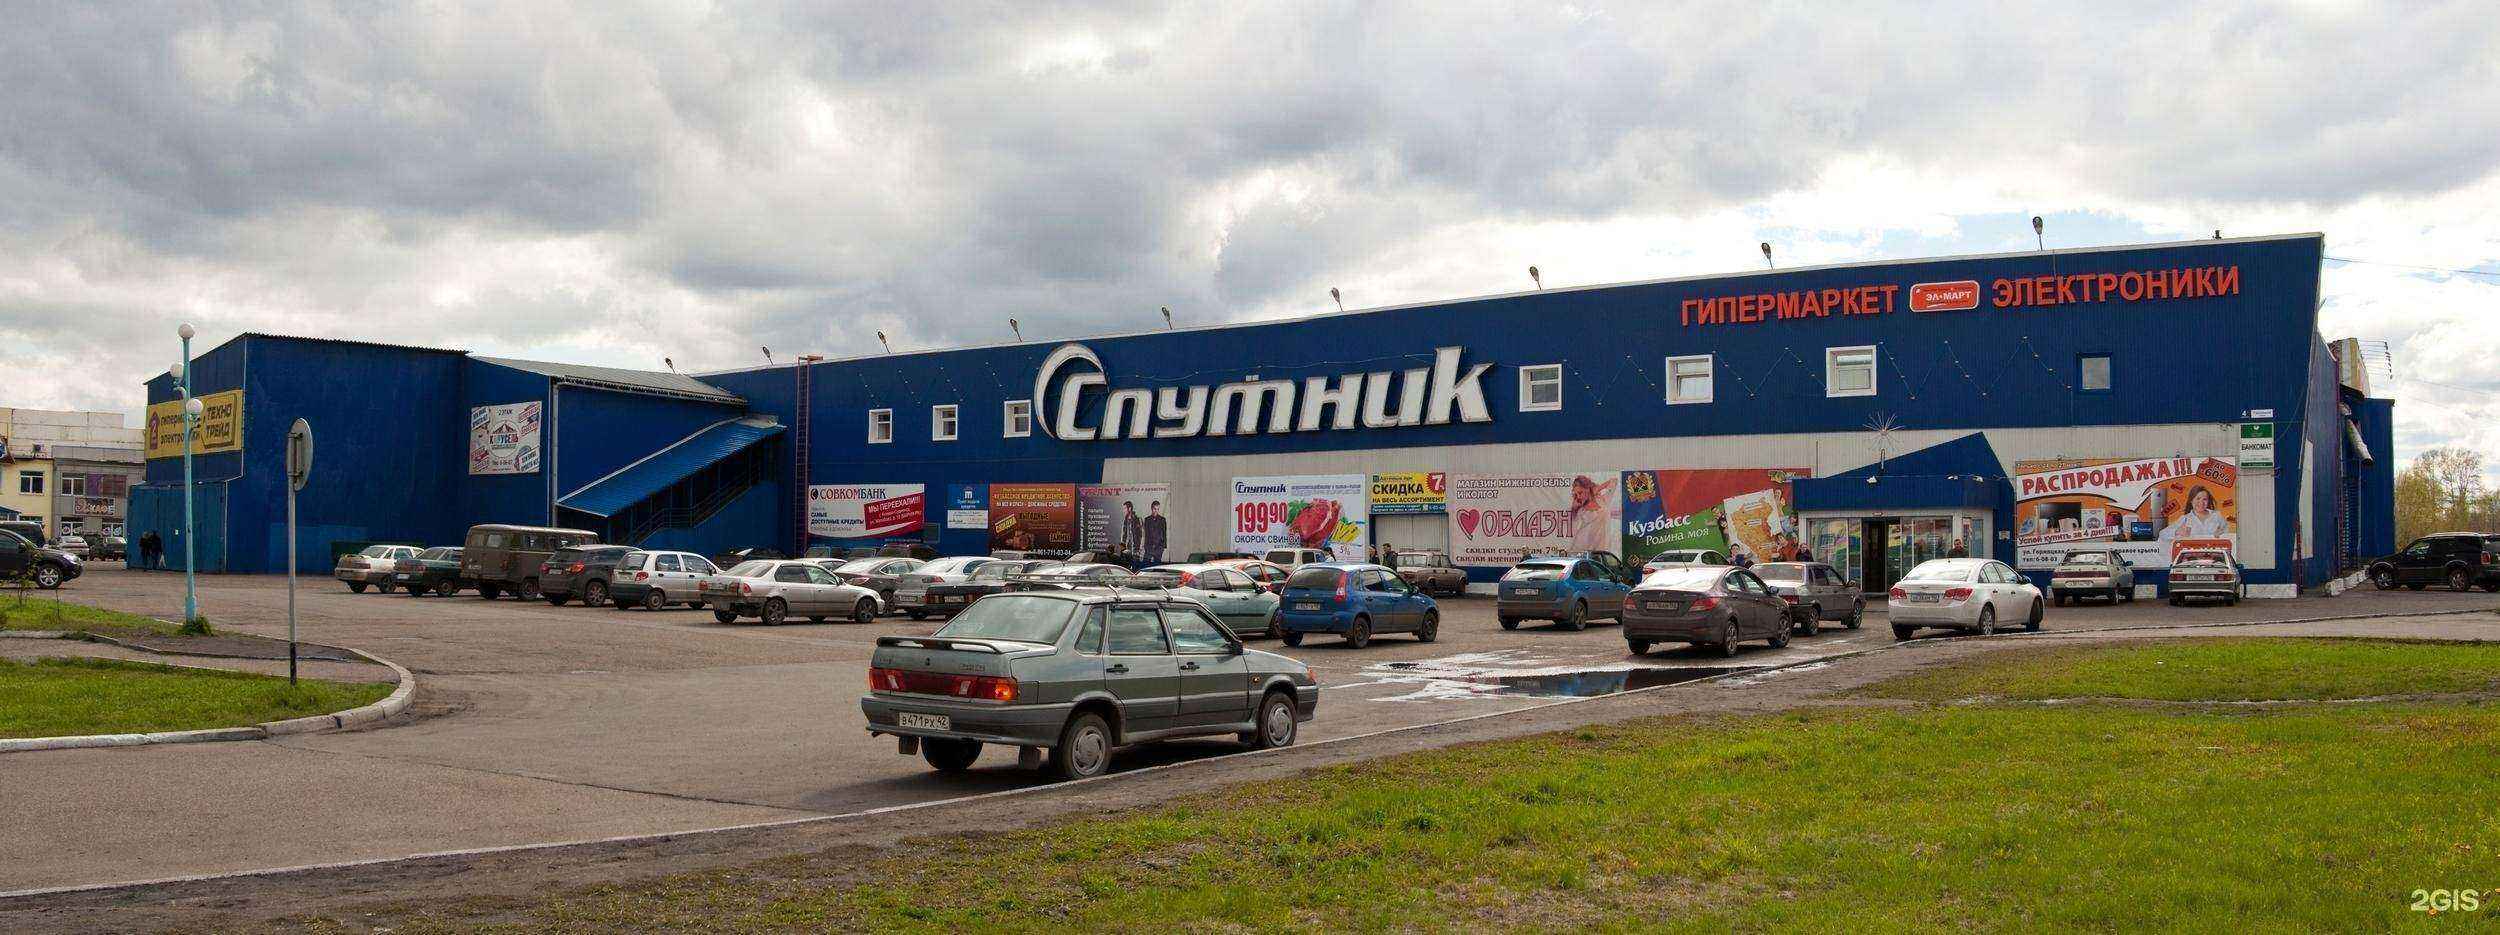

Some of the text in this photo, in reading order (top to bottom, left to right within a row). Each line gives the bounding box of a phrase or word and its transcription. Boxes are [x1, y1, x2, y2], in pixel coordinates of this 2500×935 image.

[1680, 285, 1899, 327] ГИПЕРМАРКЕТ
[1992, 265, 2240, 308] ЭЛЕКТРОНИКИ
[1034, 342, 1496, 441] Спутник
[2241, 443, 2272, 451] БАНКОМАТ
[2021, 461, 2172, 496] РАСПРОДАЖА
[2204, 468, 2230, 484] 60%
[1235, 481, 1287, 494] Спутник
[1372, 483, 1424, 496] СКИДКА
[1457, 477, 1571, 489] МАГАЗИН НИЖНЕГО БЕЛЬЯ
[820, 488, 887, 500] СОВКОМБАНК
[1457, 490, 1499, 499] И КОЛГОТ
[868, 503, 880, 513] МЫ
[1629, 514, 1692, 538] Кузбасс
[1235, 534, 1302, 543] ОКОРОК СВИНОЙ
[1646, 527, 1709, 546] Родина моя
[2018, 535, 2041, 546] Успей
[2044, 533, 2072, 544] купить
